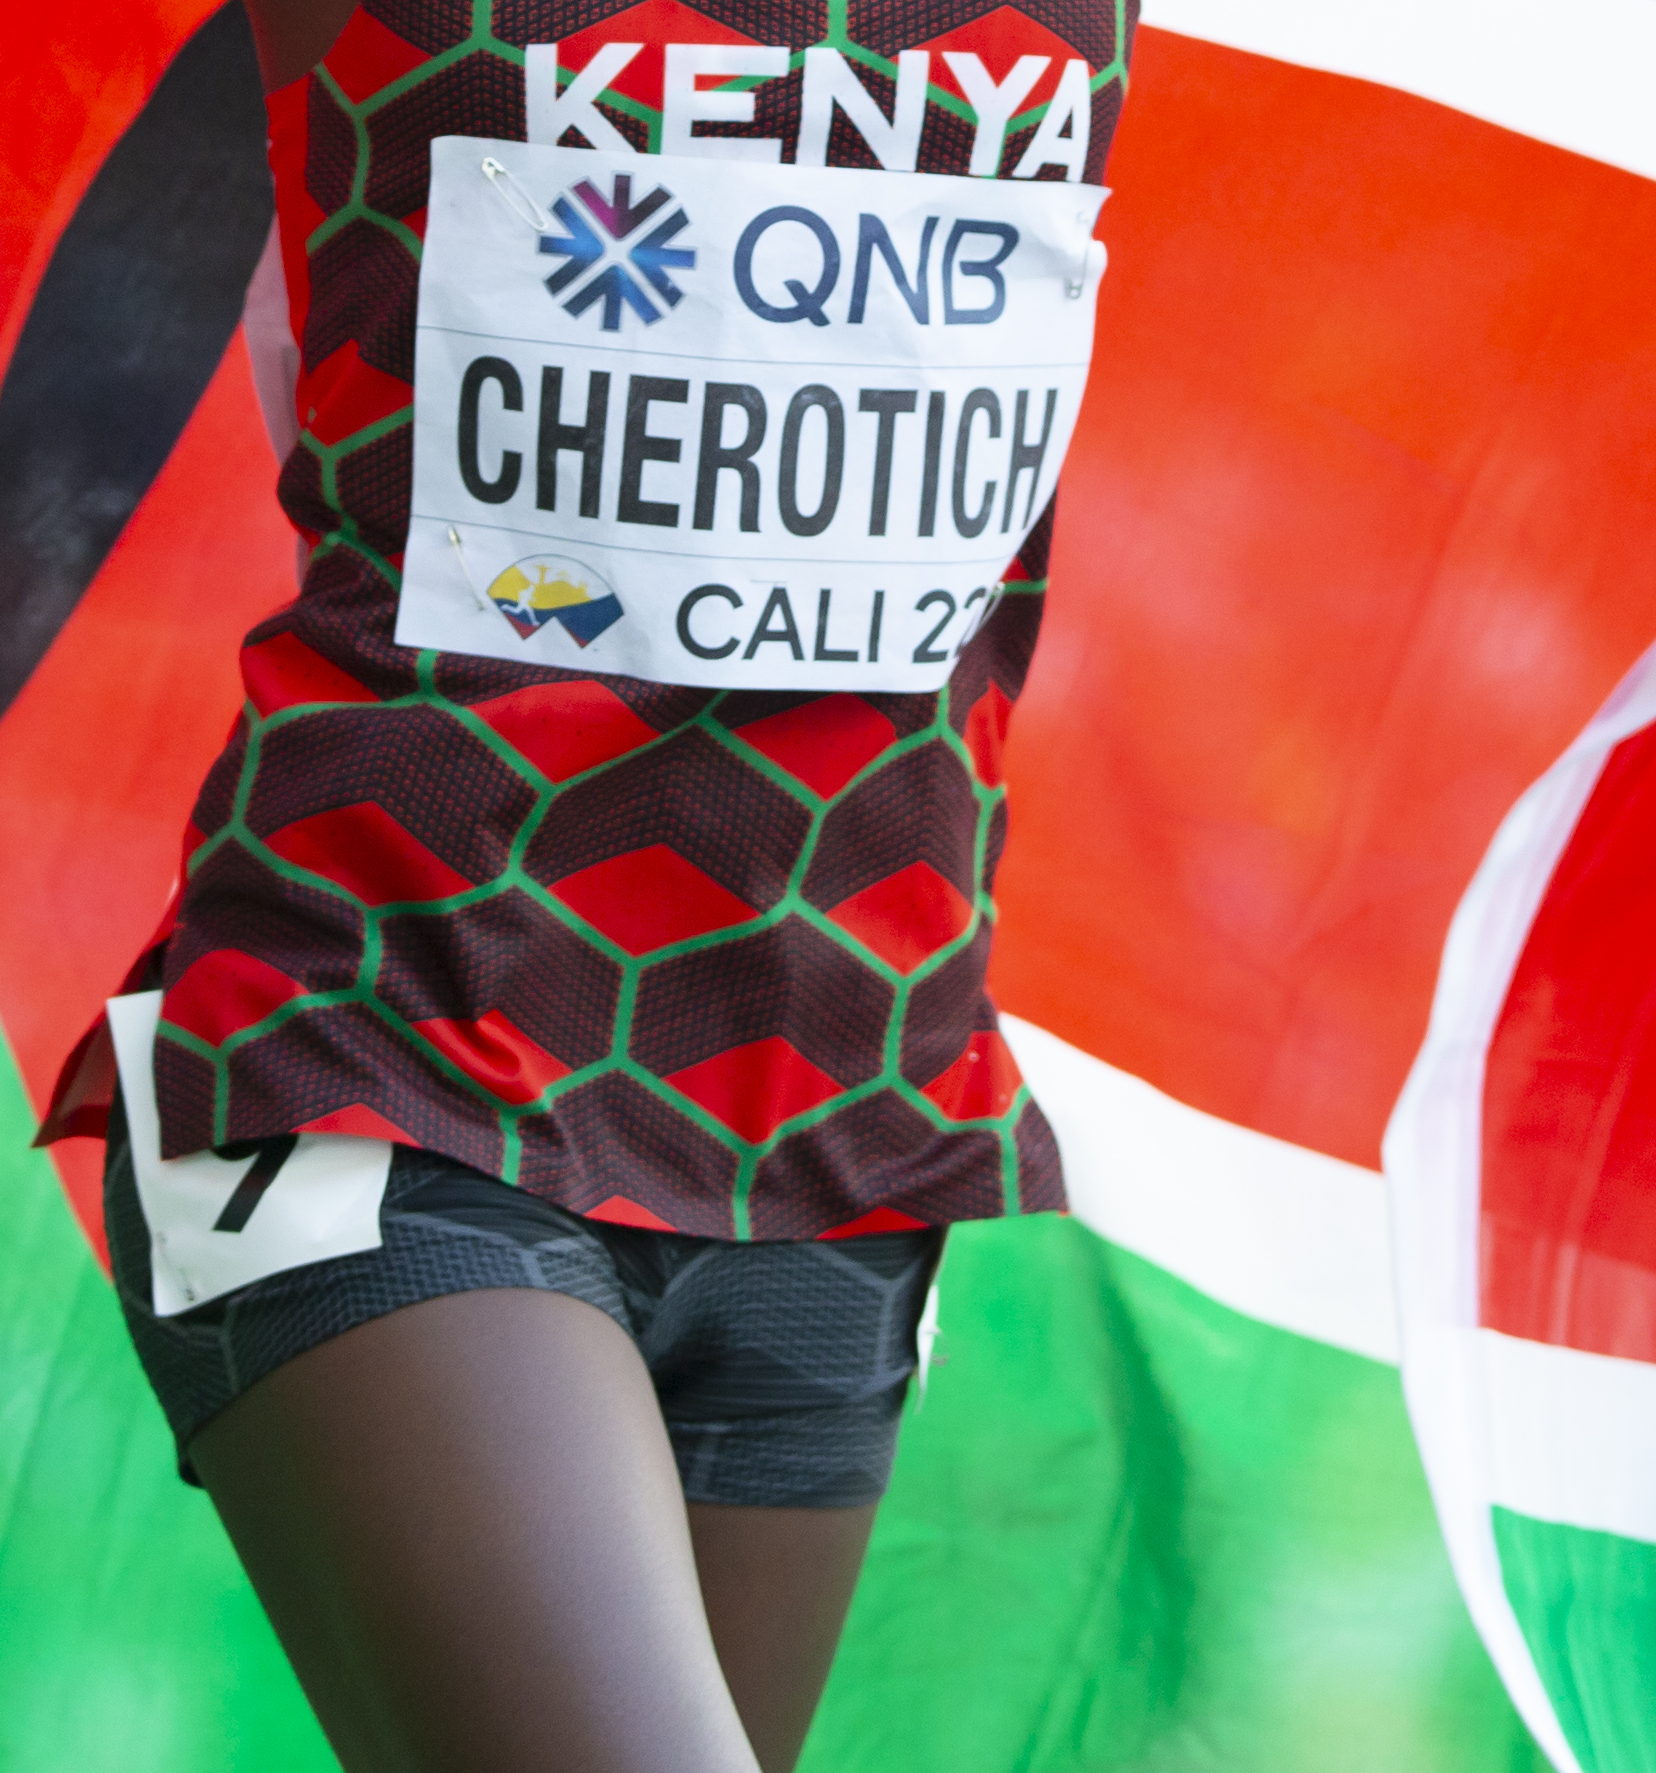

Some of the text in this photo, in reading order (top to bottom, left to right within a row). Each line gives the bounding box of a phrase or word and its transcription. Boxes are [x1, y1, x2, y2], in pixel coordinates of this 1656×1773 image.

[524, 41, 1092, 182] KENYA
[733, 204, 1020, 327] QNB
[457, 355, 1058, 540] CHEROTICH
[675, 583, 886, 663] CALI
